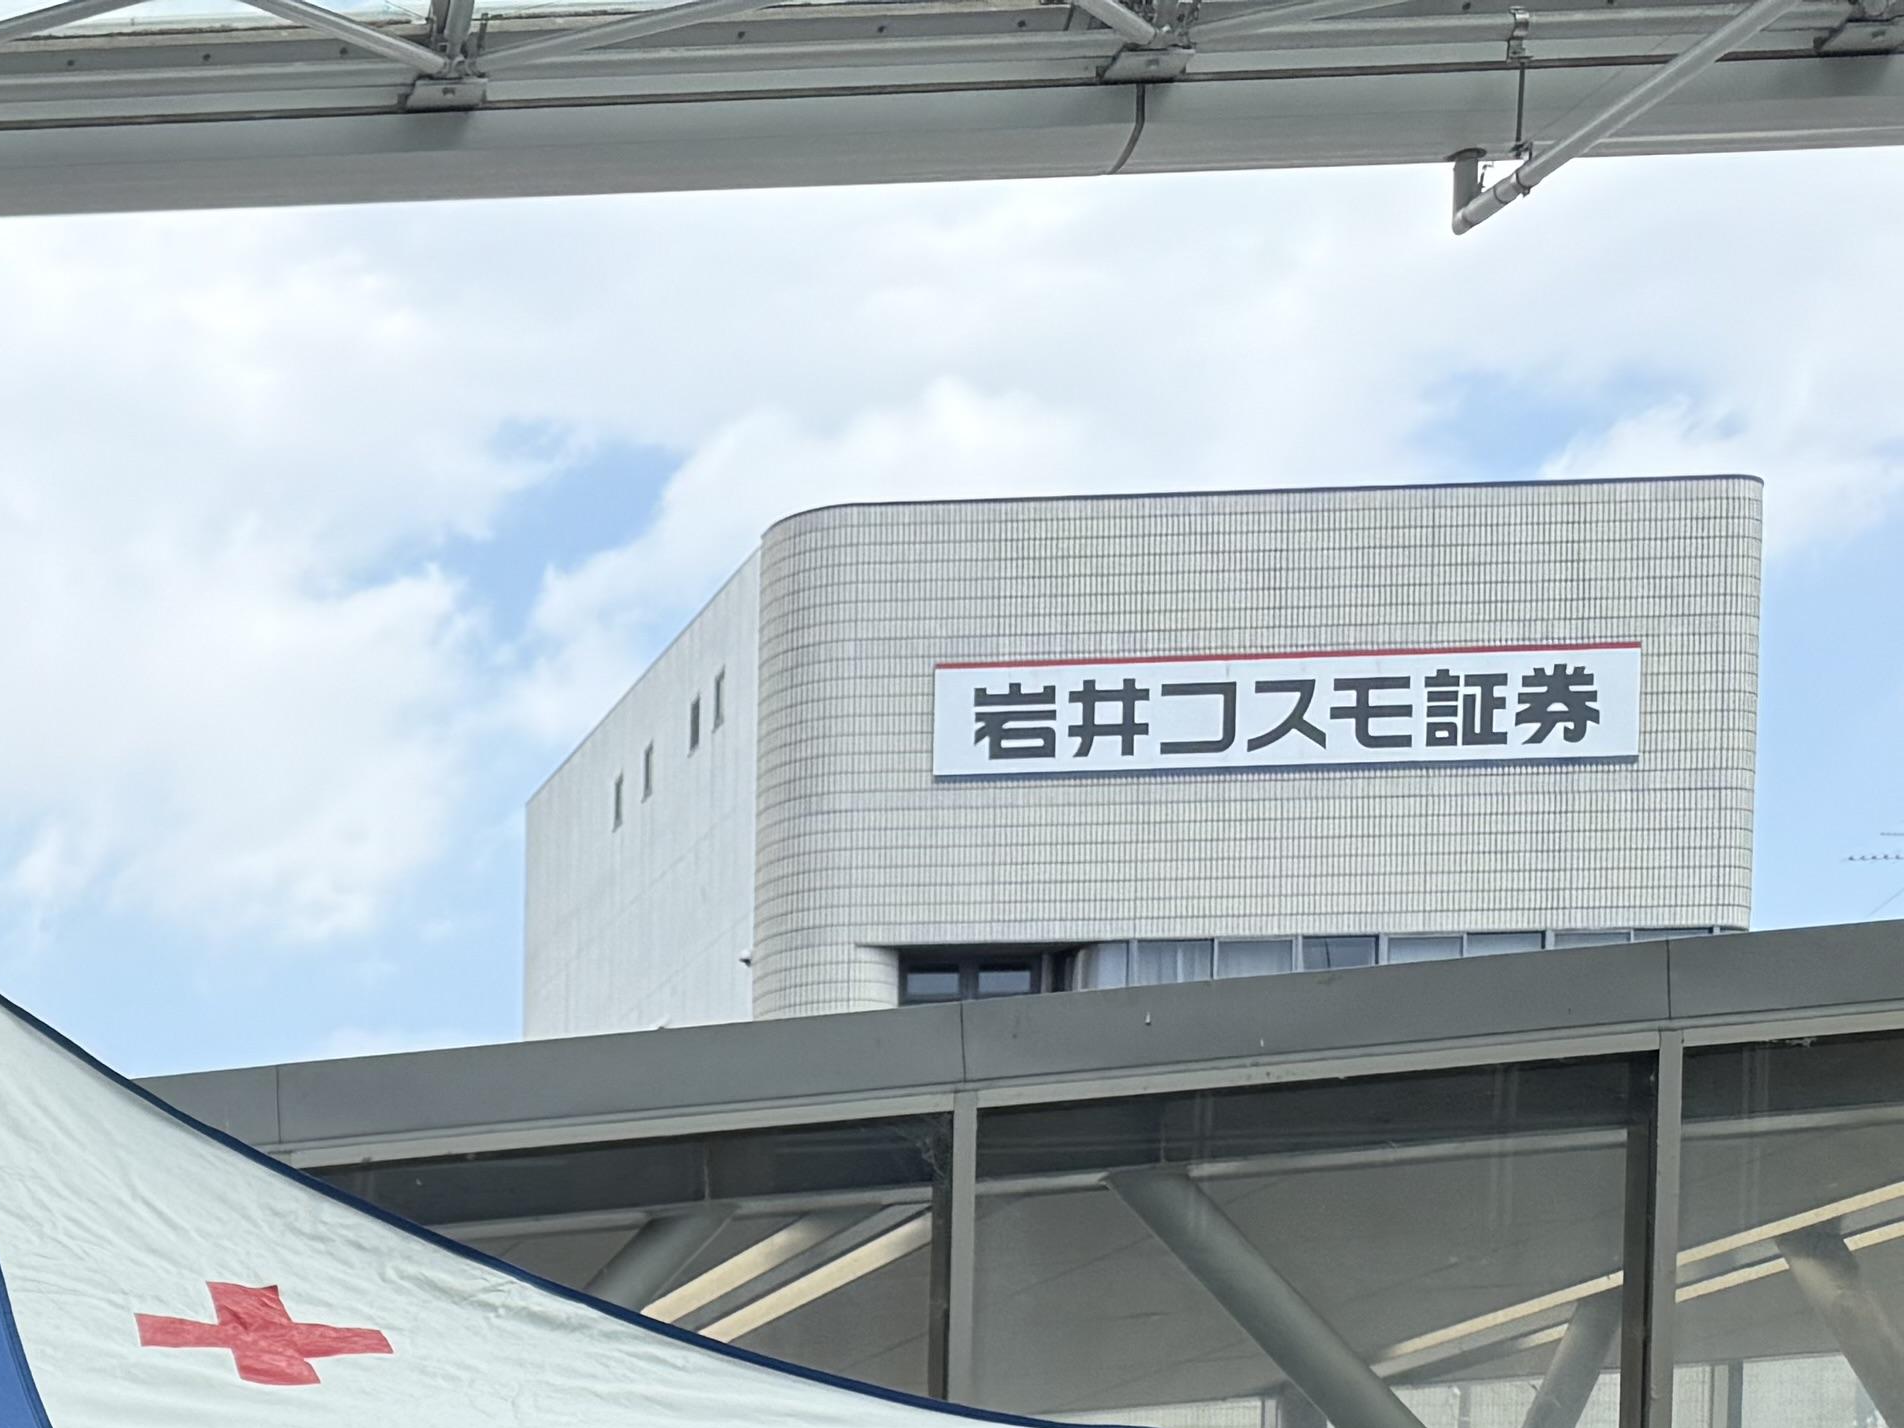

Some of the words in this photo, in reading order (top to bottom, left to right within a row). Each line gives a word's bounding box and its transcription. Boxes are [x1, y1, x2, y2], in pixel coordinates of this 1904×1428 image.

[973, 663, 1601, 760] 岩井コスモ証券
